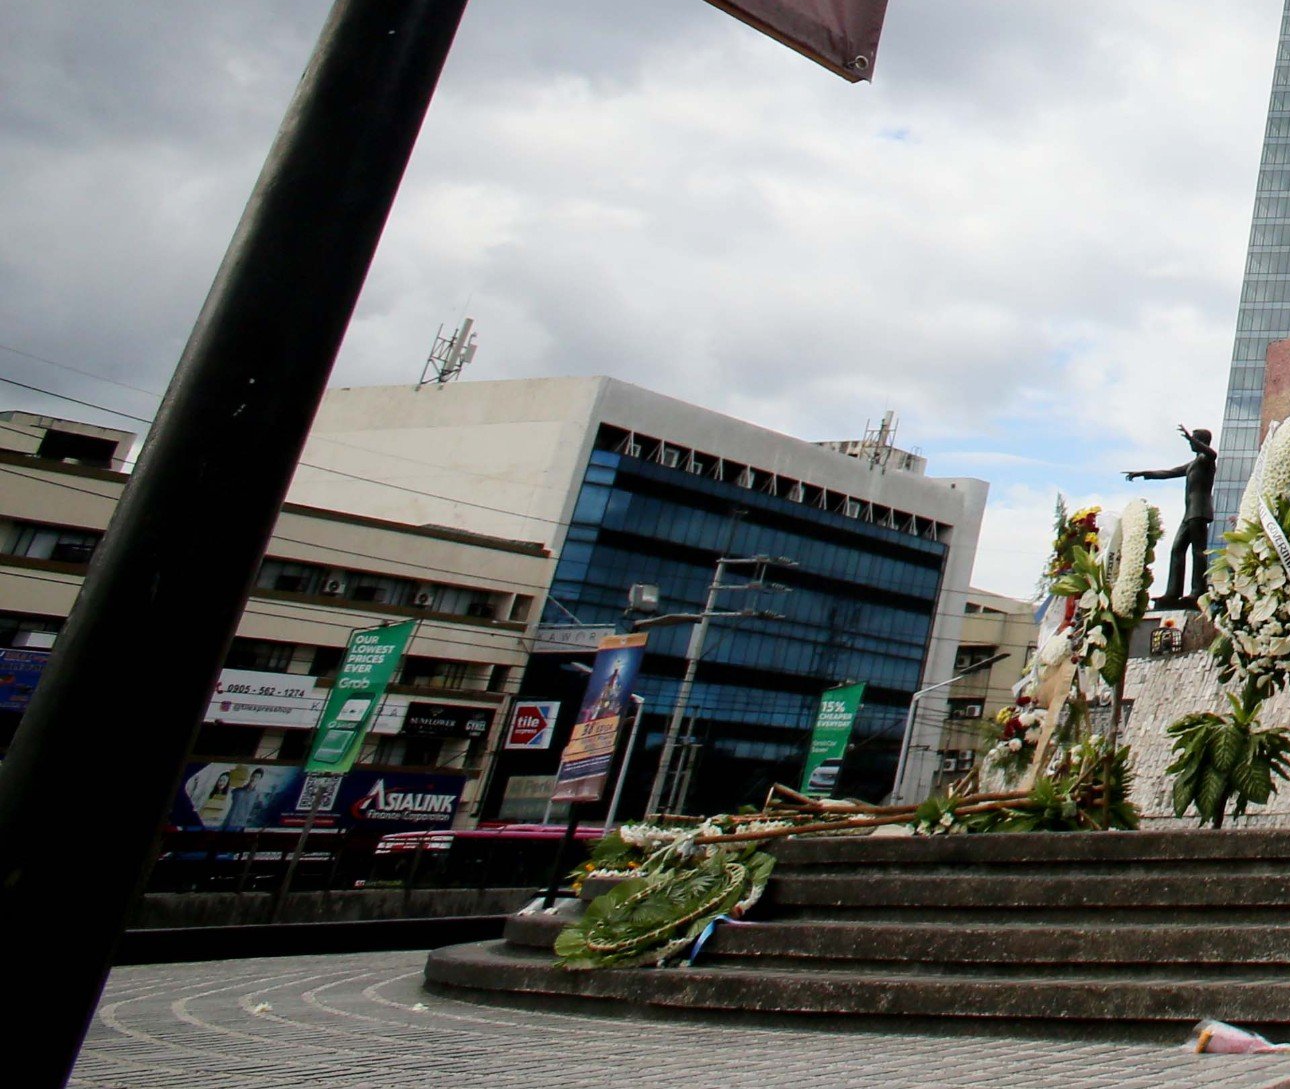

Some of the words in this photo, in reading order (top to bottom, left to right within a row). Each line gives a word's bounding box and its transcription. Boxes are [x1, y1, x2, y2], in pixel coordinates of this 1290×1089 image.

[355, 635, 380, 644] OUR
[351, 645, 396, 654] LOWEST
[347, 654, 385, 663] PRICES
[343, 664, 373, 673] EVER
[338, 677, 370, 689] Grab
[821, 701, 846, 712] 15%
[517, 716, 540, 728] tile
[361, 778, 457, 812] ASIALINK
